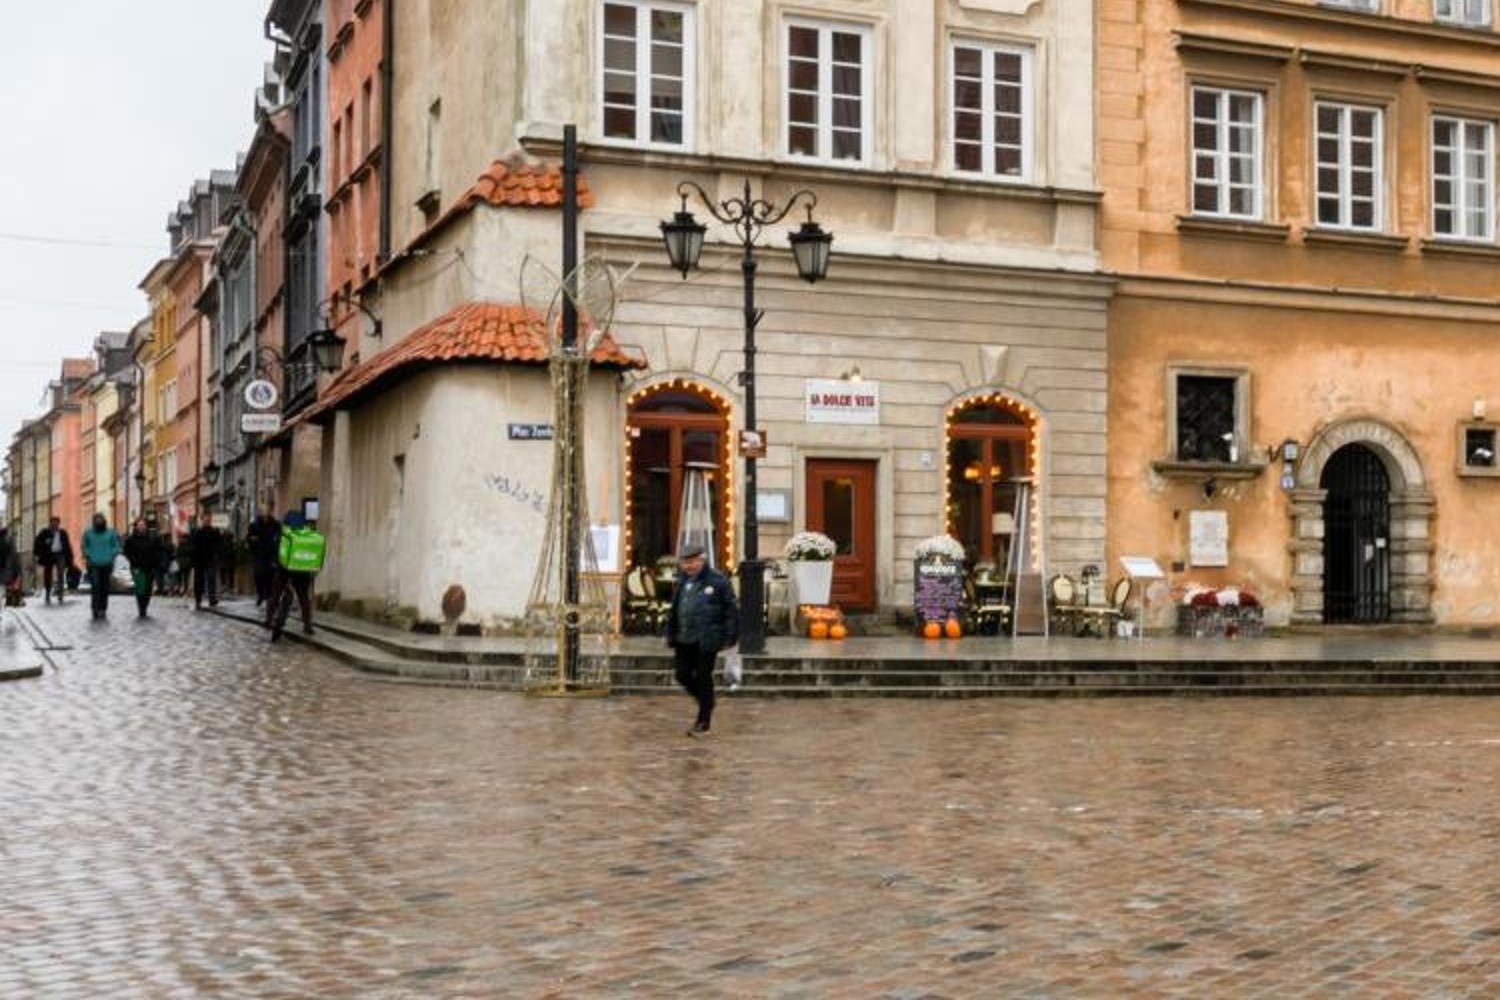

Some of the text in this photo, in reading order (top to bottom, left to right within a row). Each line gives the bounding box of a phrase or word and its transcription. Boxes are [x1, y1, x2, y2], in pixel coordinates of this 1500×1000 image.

[810, 394, 875, 407] LA DOLCE VITA
